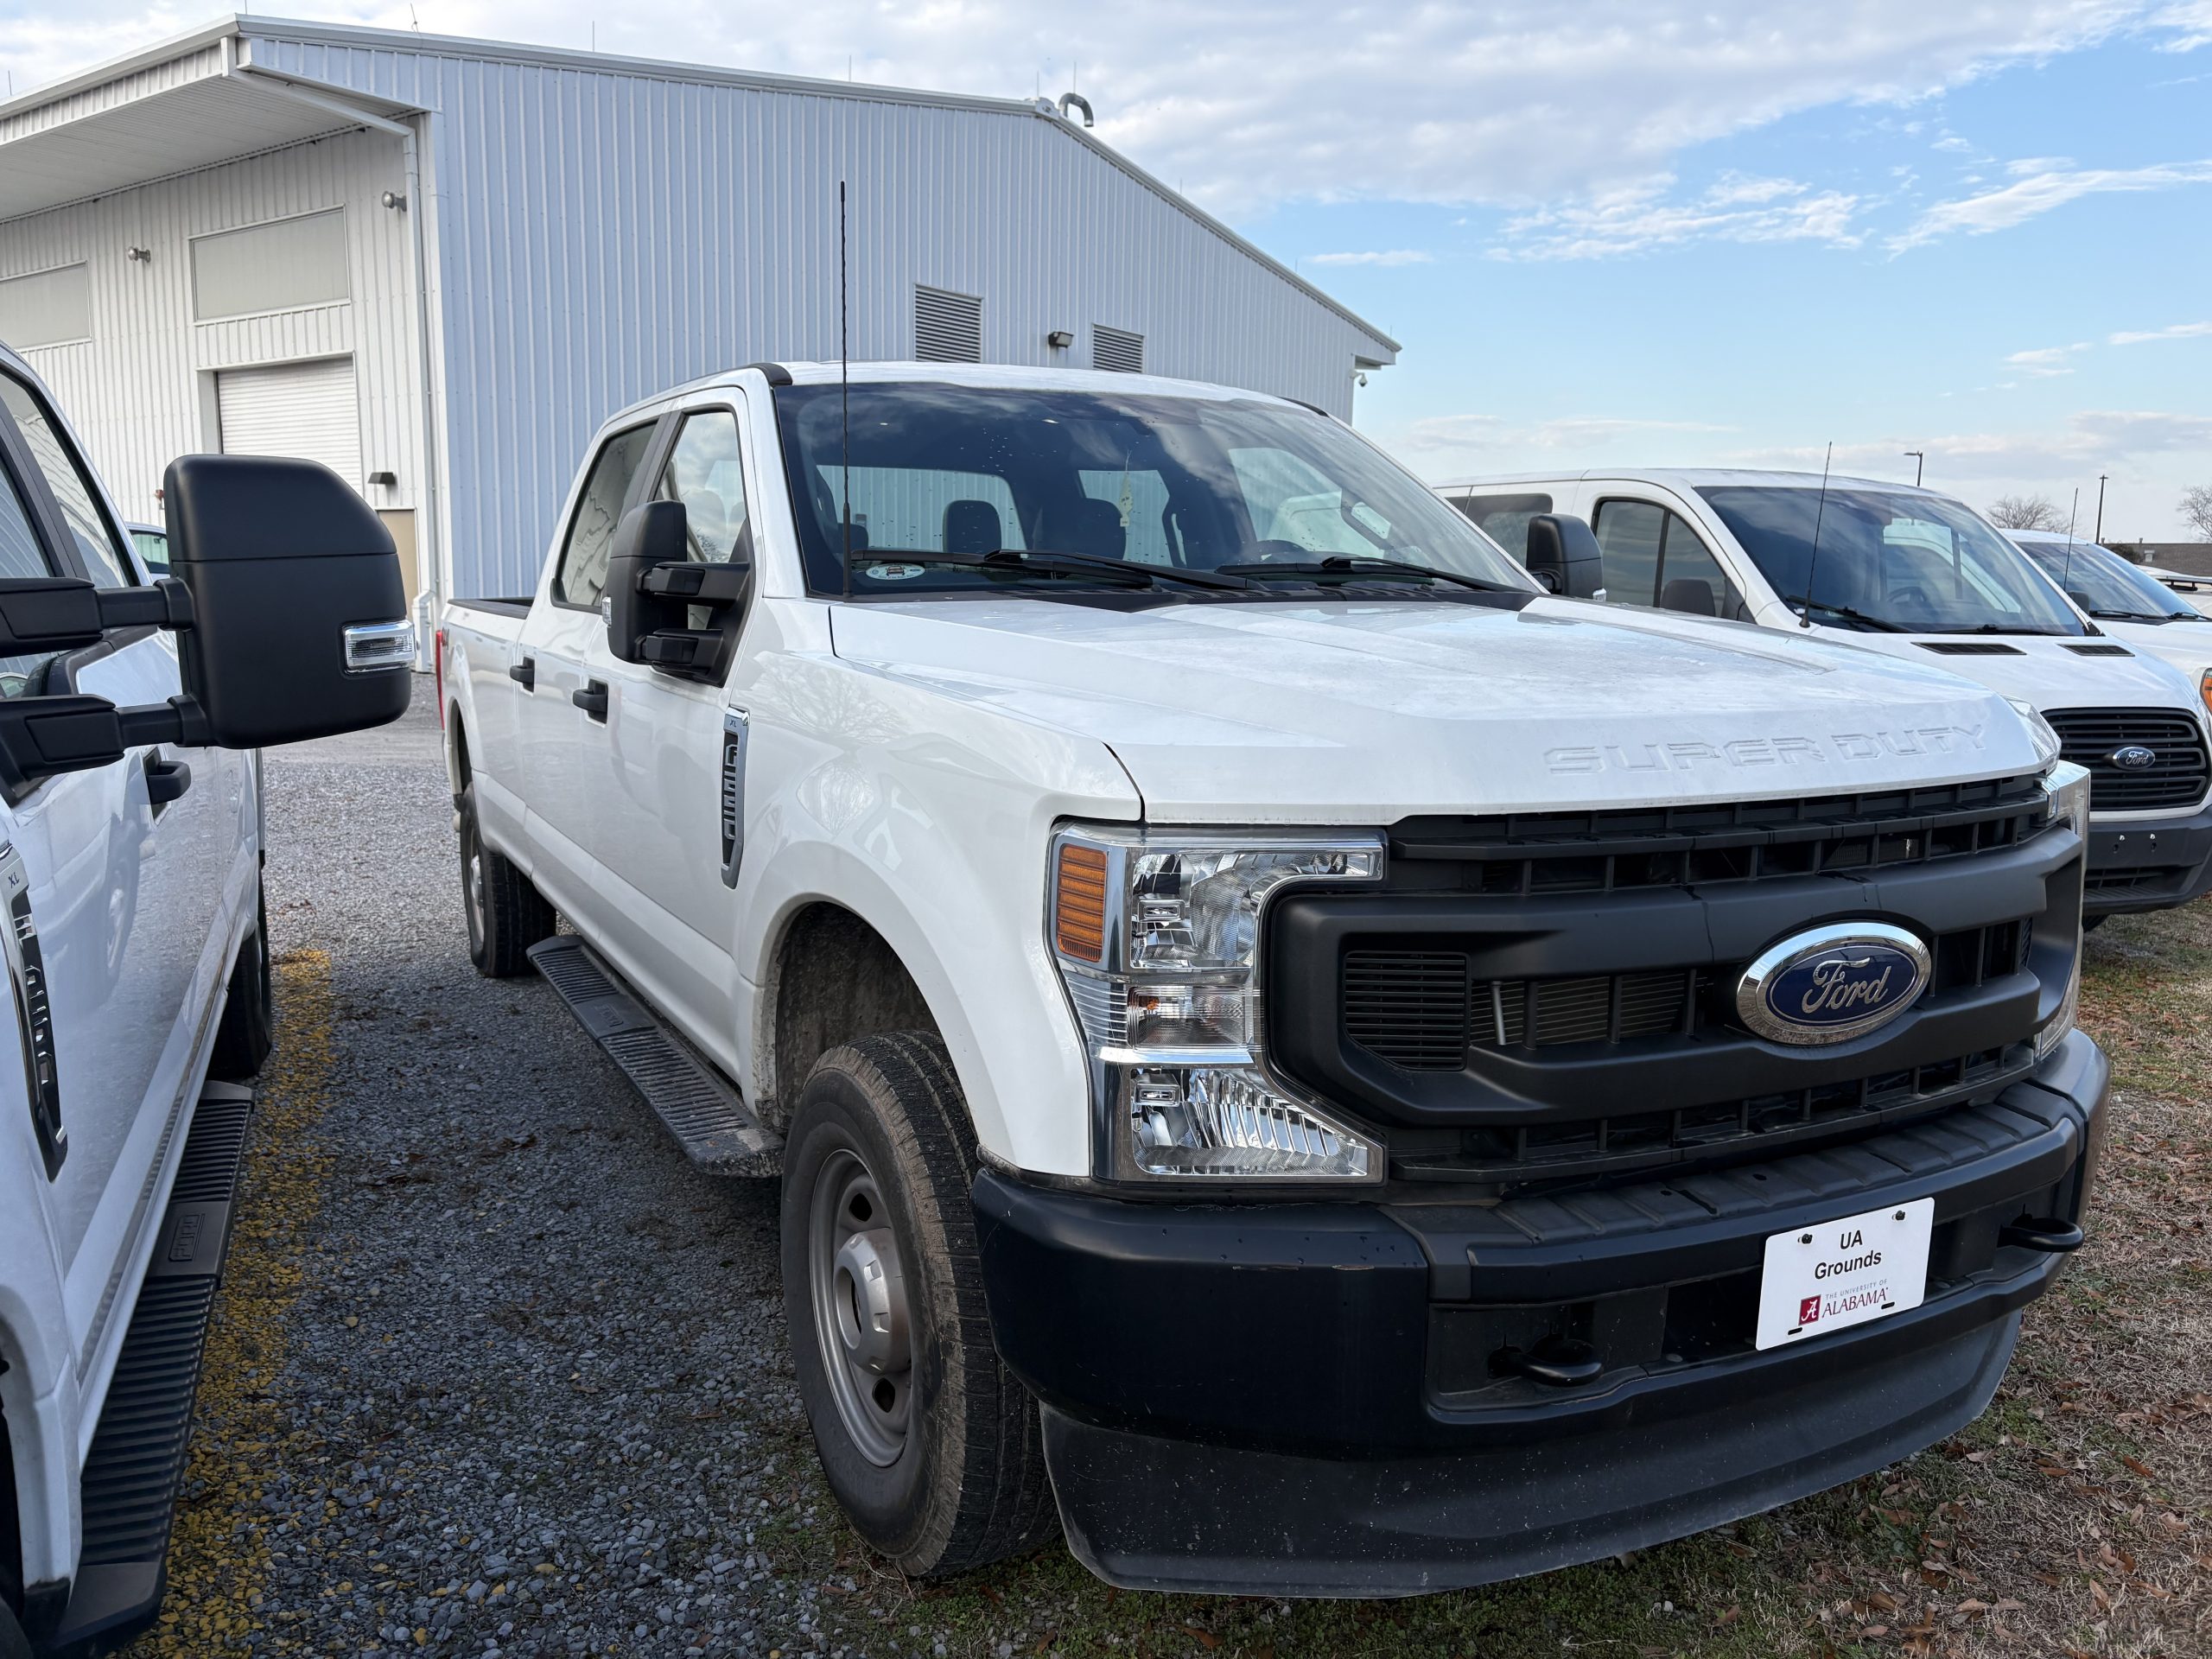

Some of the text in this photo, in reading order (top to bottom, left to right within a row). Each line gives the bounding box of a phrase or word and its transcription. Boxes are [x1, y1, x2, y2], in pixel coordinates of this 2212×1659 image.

[1543, 723, 1986, 775] SUPER DUTY
[2126, 750, 2149, 765] Ford
[1802, 957, 1891, 1014] Ford
[1840, 1230, 1863, 1249] UA
[1815, 1249, 1882, 1280] Grounds
[1822, 1288, 1887, 1319] ALABAMA
[1826, 1292, 1837, 1300] THE
[1840, 1281, 1877, 1296] UNIVERSITY
